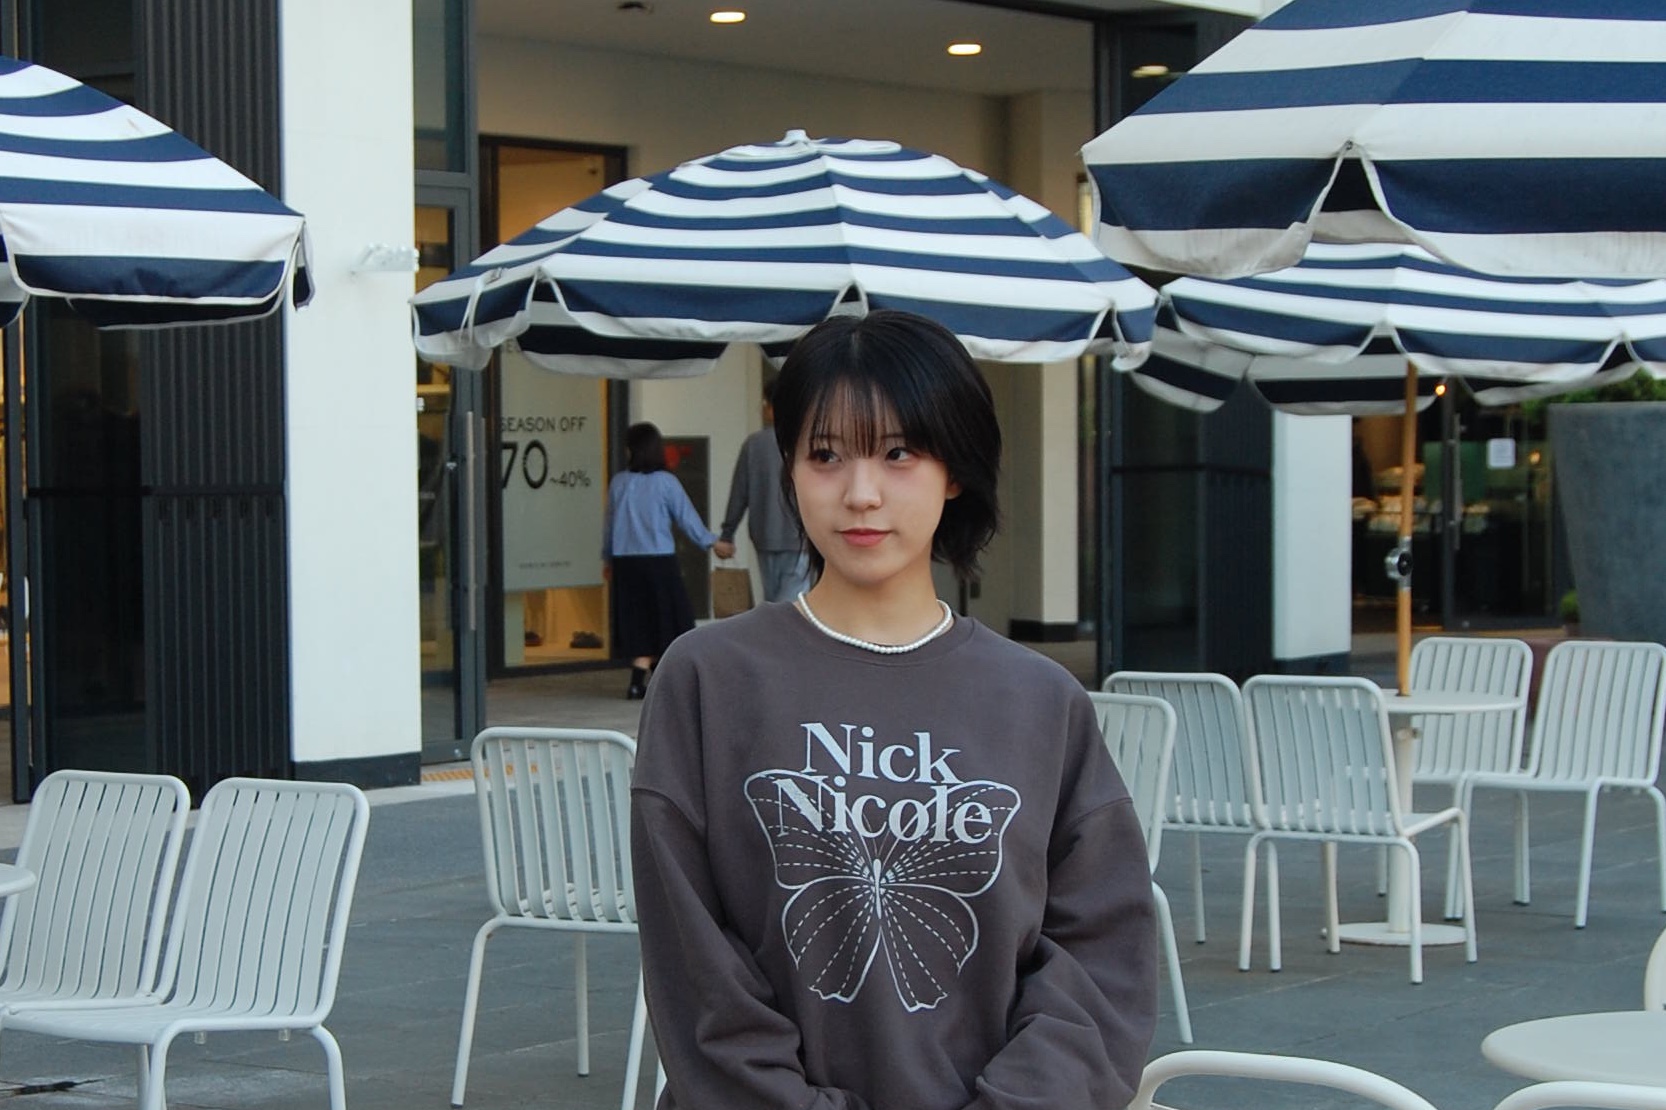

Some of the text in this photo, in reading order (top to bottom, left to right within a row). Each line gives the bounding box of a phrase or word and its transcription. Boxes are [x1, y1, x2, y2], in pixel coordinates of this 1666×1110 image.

[560, 415, 587, 431] OFF
[801, 722, 963, 784] Nick
[773, 775, 993, 844] Nicole
